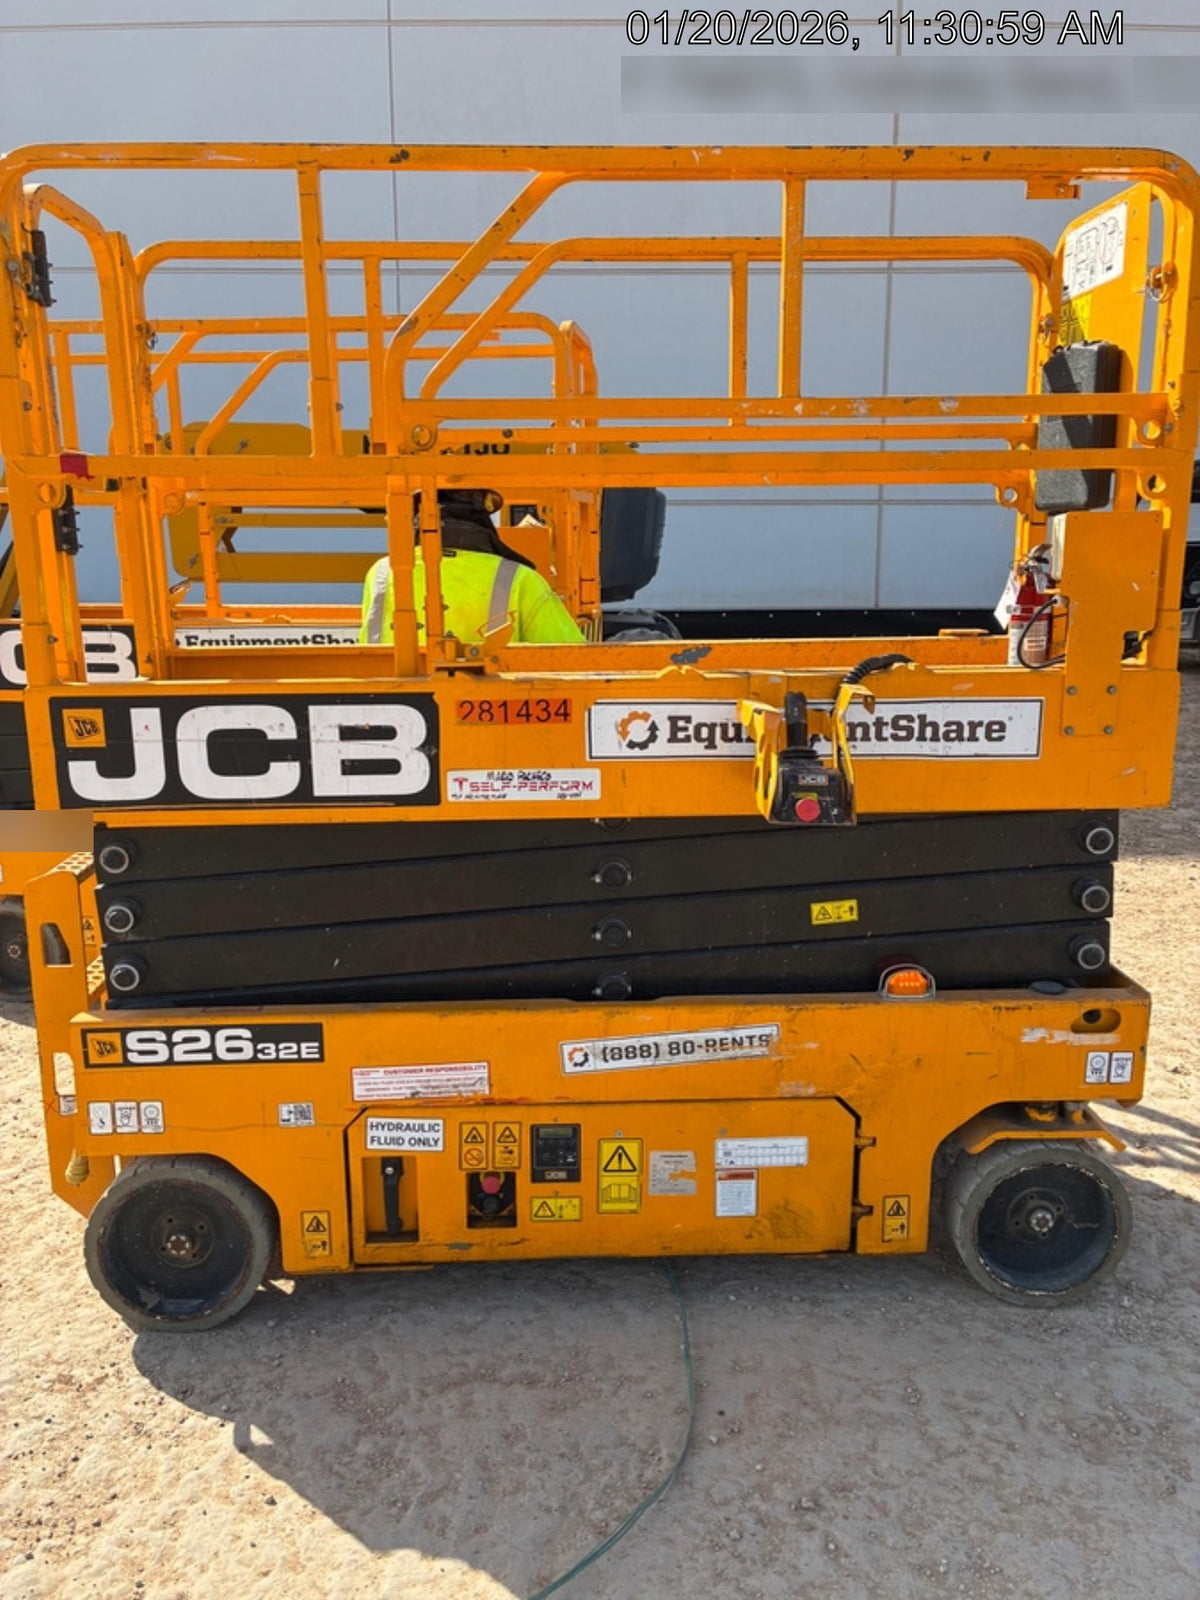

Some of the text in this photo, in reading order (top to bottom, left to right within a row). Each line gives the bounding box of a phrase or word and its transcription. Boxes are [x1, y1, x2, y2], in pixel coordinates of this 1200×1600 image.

[185, 634, 359, 646] EquipmentSha
[459, 698, 571, 723] 281434
[70, 716, 100, 739] JCB
[667, 713, 1006, 750] EquntShare
[68, 705, 431, 801] JCB
[469, 780, 593, 792] SELF-PERFORM
[602, 1043, 659, 1063] (888)
[369, 1121, 441, 1133] HYDRAULIC
[369, 1136, 440, 1147] FLUID ONLY
